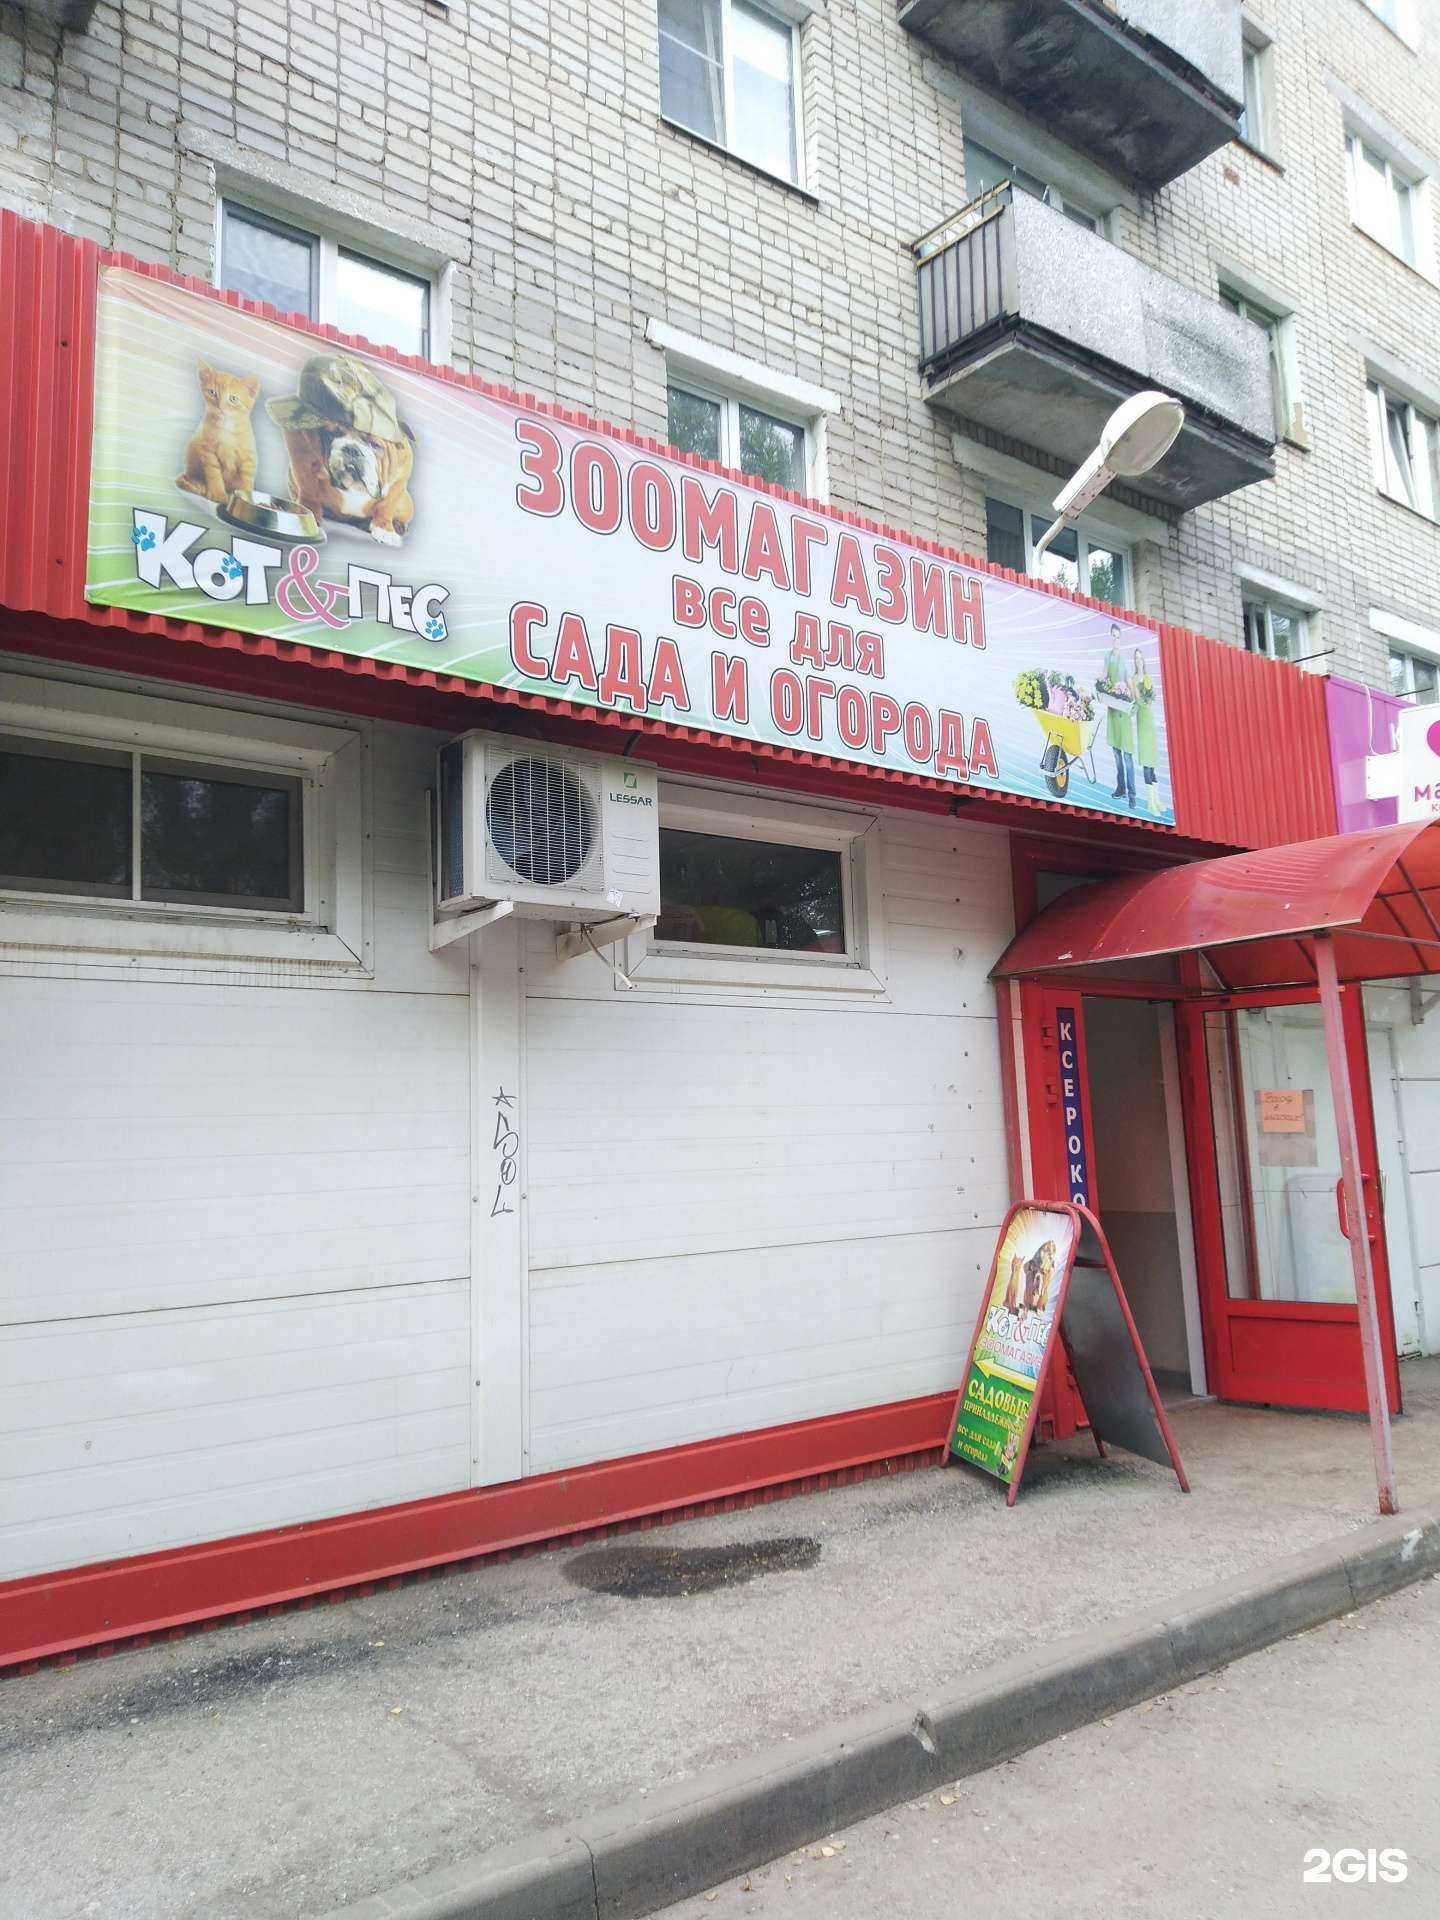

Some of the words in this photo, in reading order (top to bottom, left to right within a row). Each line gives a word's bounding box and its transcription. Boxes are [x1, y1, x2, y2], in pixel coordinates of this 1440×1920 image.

[515, 417, 987, 650] ЗООМАГАЗИН
[672, 574, 770, 647] все
[790, 611, 885, 679] для
[508, 601, 691, 713] САДА
[711, 651, 750, 725] И
[769, 668, 999, 781] ОГОРОДА
[609, 792, 653, 807] LESSAR
[968, 1379, 1030, 1421] САДОВЫЕ
